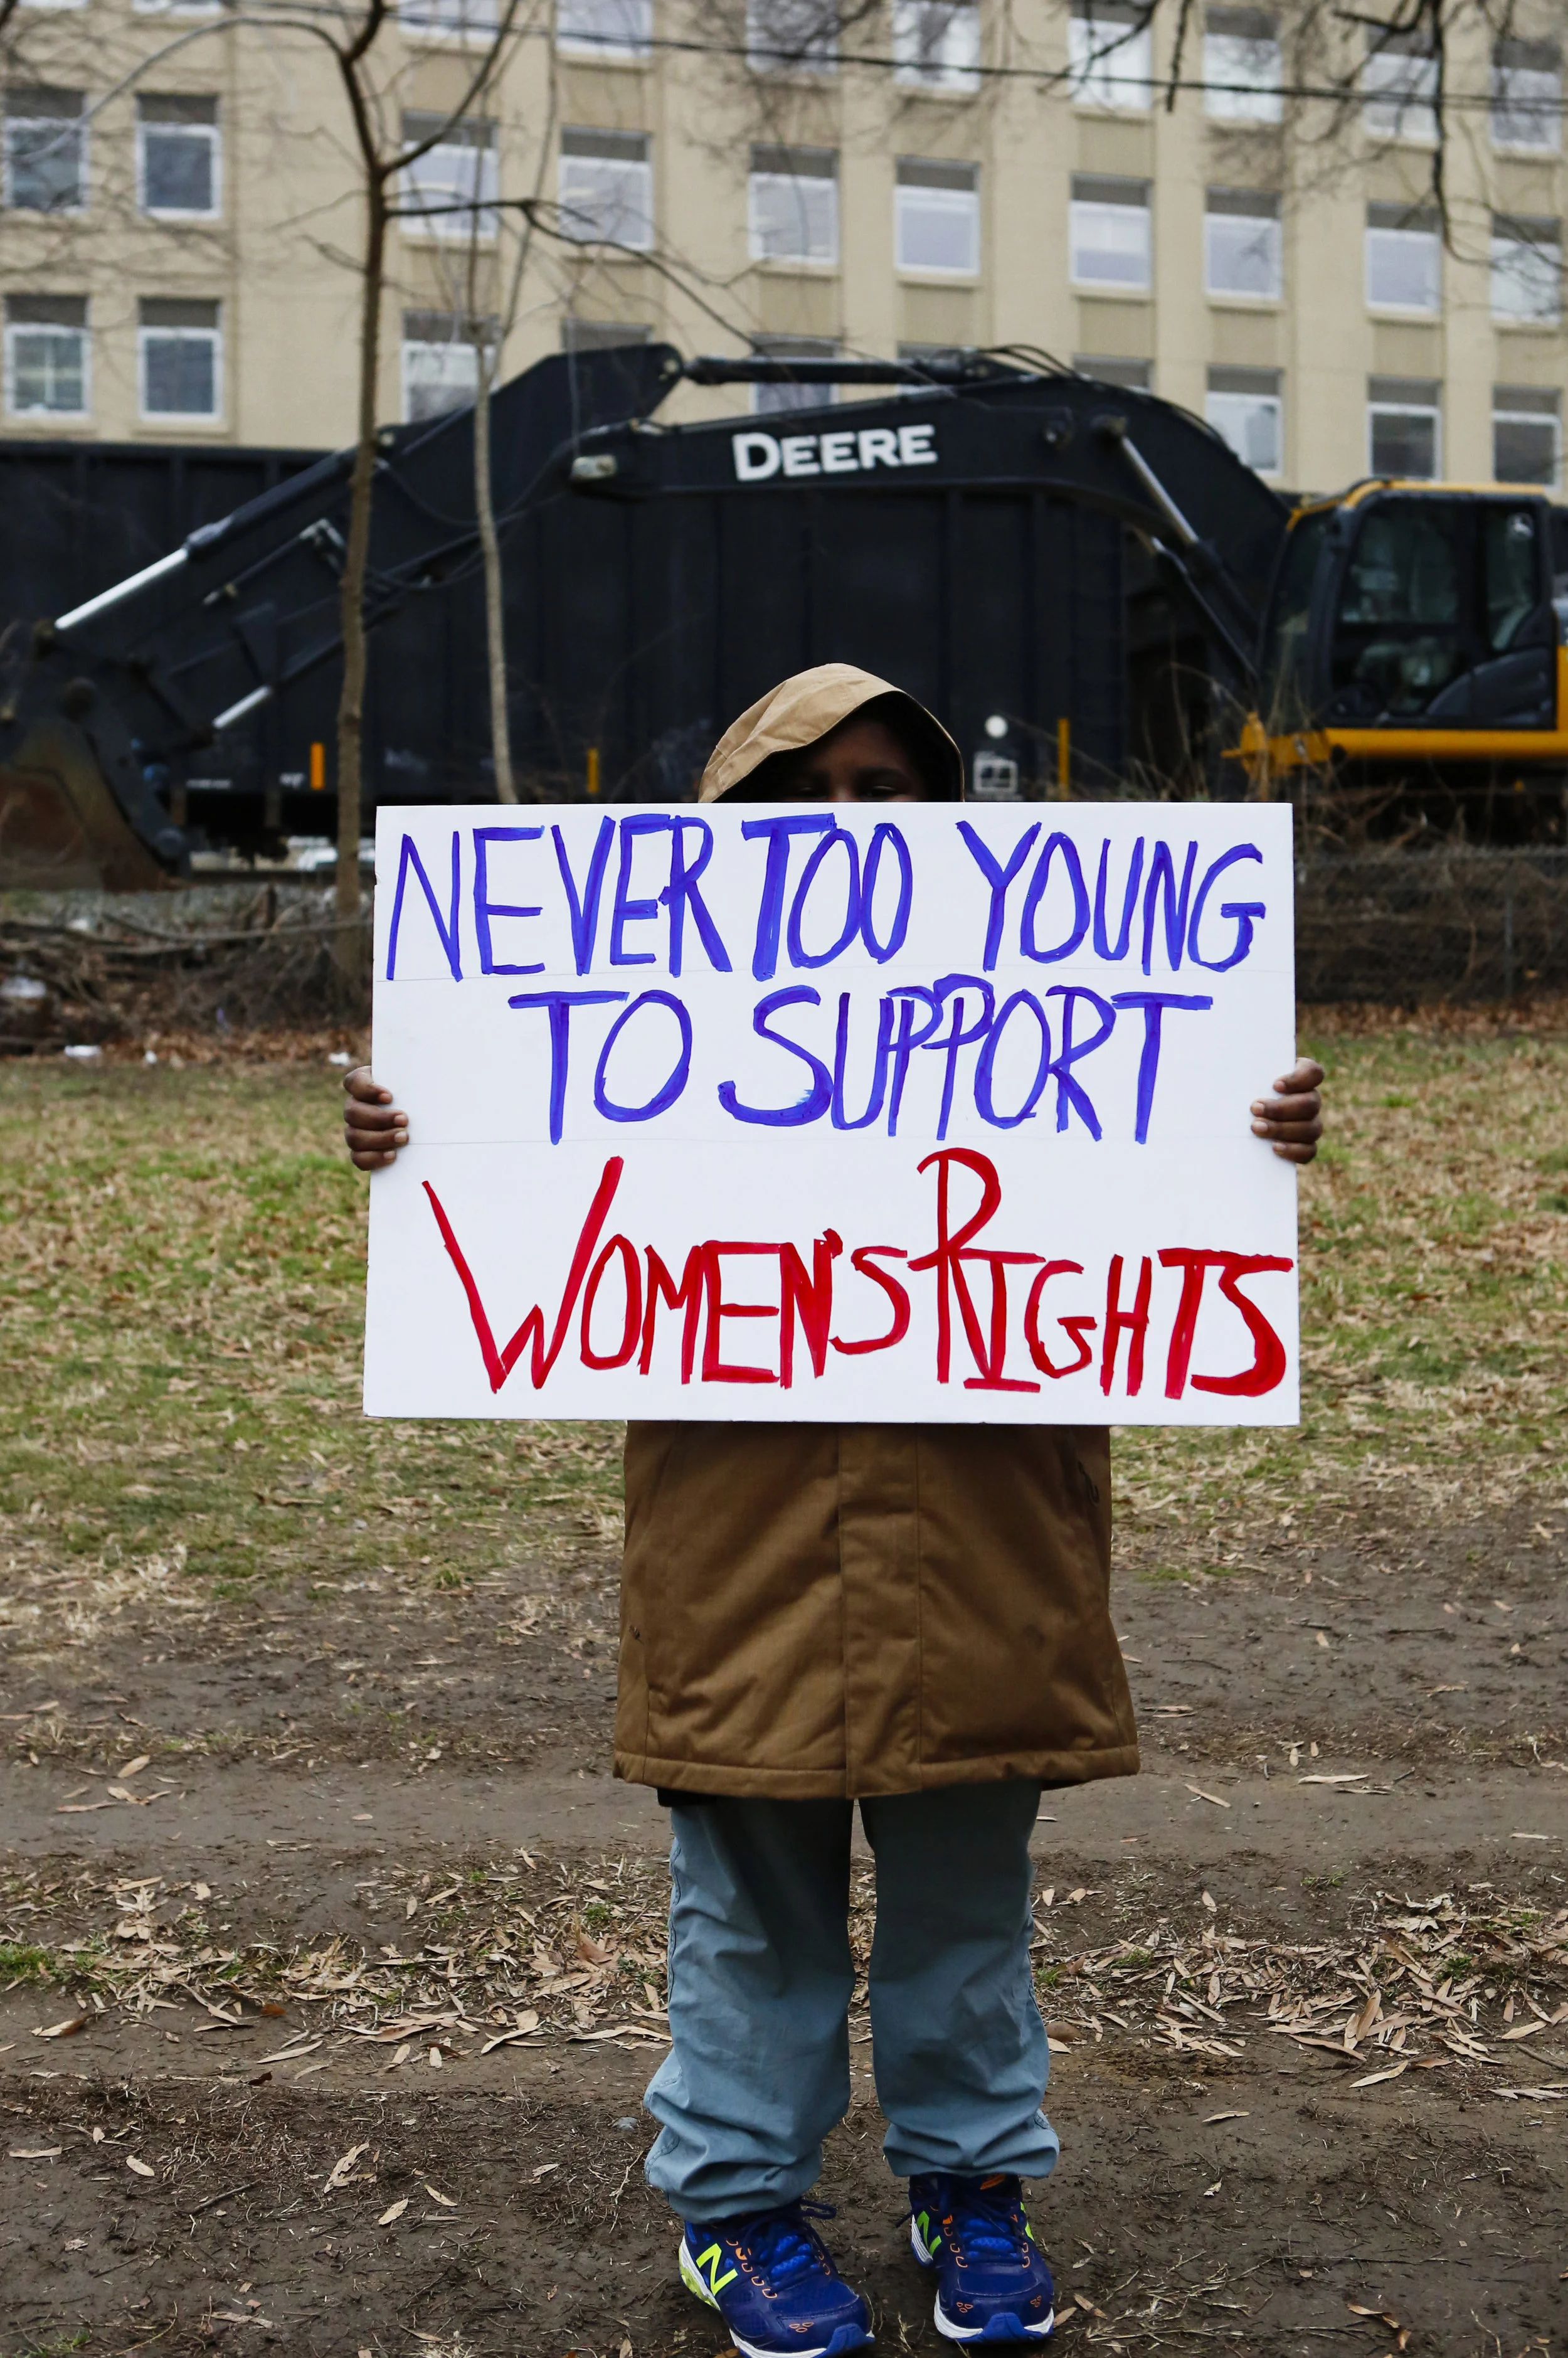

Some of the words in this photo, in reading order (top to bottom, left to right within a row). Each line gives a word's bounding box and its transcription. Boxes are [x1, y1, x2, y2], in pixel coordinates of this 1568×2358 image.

[732, 423, 938, 482] DEERE
[385, 813, 734, 982] NEVER
[740, 812, 913, 982] TOO
[955, 820, 1266, 977] YOUNG
[507, 989, 693, 1145] TO
[717, 973, 1214, 1145] SUPPORT
[422, 1156, 911, 1393] WOMEN'S
[908, 1147, 1294, 1399] RIGHTS
